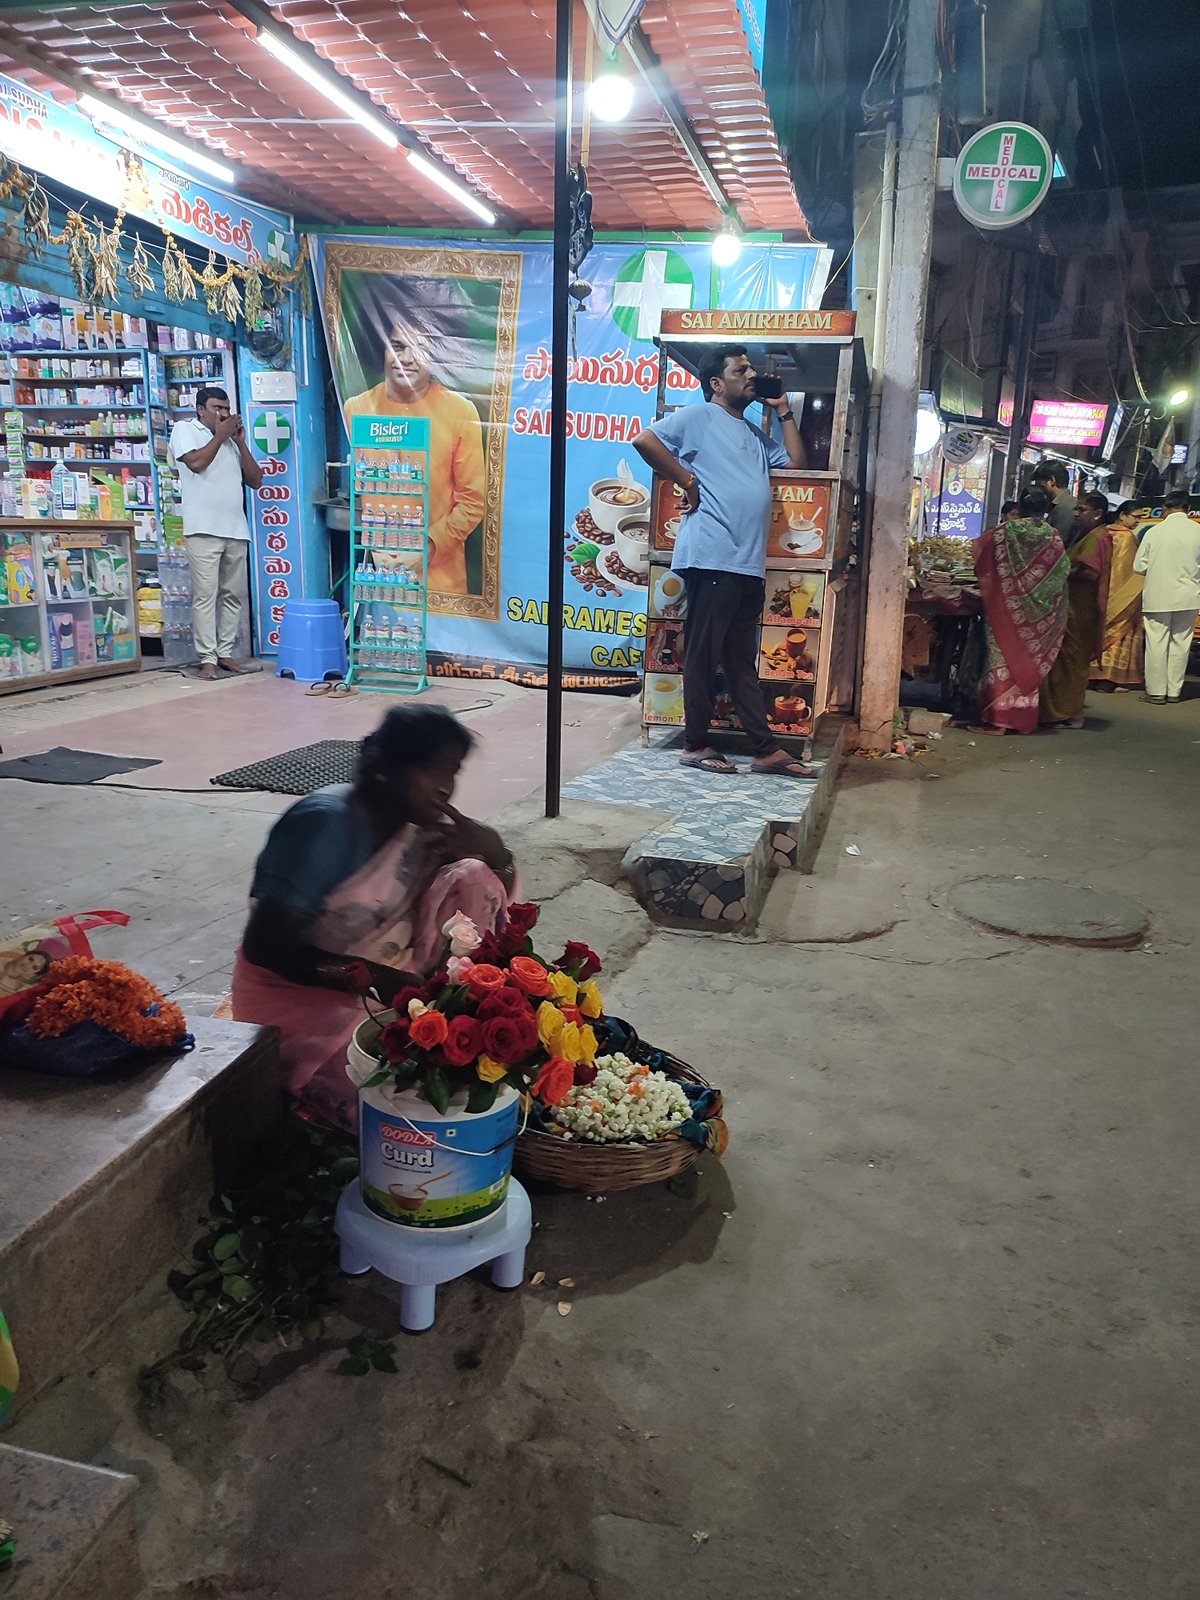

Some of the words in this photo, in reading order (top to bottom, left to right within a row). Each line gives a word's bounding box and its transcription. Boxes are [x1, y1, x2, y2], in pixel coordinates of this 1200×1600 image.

[11, 88, 48, 120] SUDHA
[968, 166, 1038, 179] MEDICAL
[994, 135, 1014, 209] MEDICAL
[681, 312, 713, 329] SAI
[717, 312, 832, 330] AMIRTHAM
[370, 421, 409, 437] Bisleri
[566, 411, 643, 442] SUDHA
[1141, 507, 1163, 518] 3G
[507, 596, 549, 626] SAI
[562, 603, 648, 638] RAMES
[661, 608, 679, 618] Tea
[649, 661, 679, 672] Boost
[797, 670, 814, 680] Tea
[644, 713, 674, 723] lemon
[788, 724, 810, 734] Tea
[382, 1126, 434, 1145] DODLA
[381, 1142, 434, 1167] Curd
